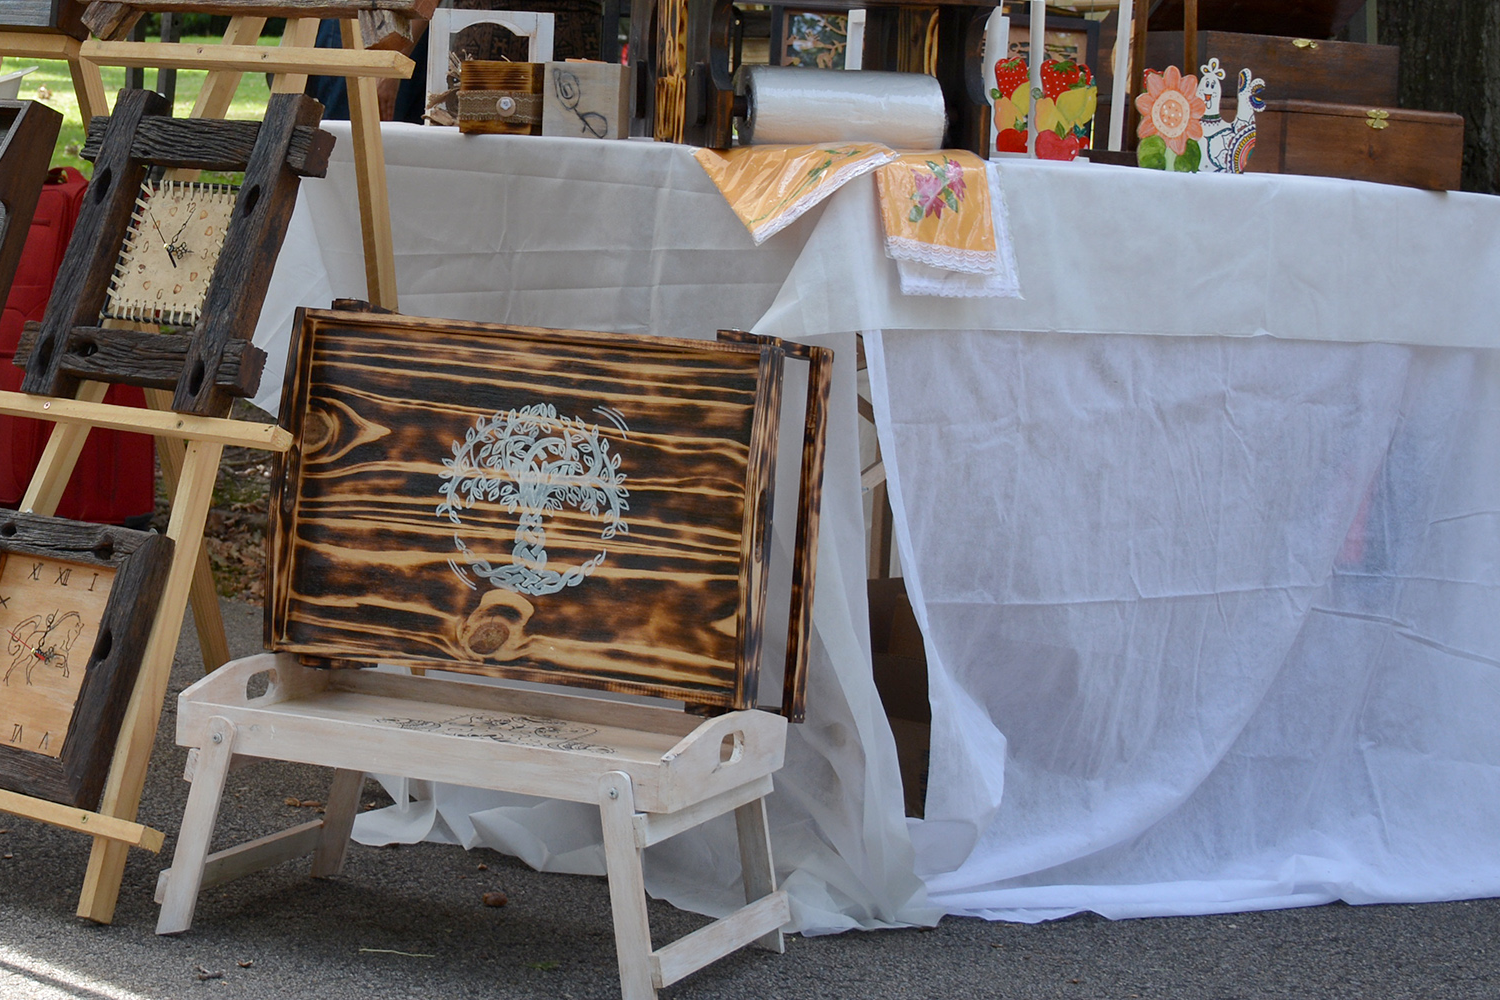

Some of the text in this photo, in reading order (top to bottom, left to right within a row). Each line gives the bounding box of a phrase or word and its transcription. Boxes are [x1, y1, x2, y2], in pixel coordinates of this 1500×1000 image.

[186, 202, 197, 213] 12
[201, 248, 208, 259] 3
[28, 562, 44, 580] XI
[54, 567, 72, 586] XII
